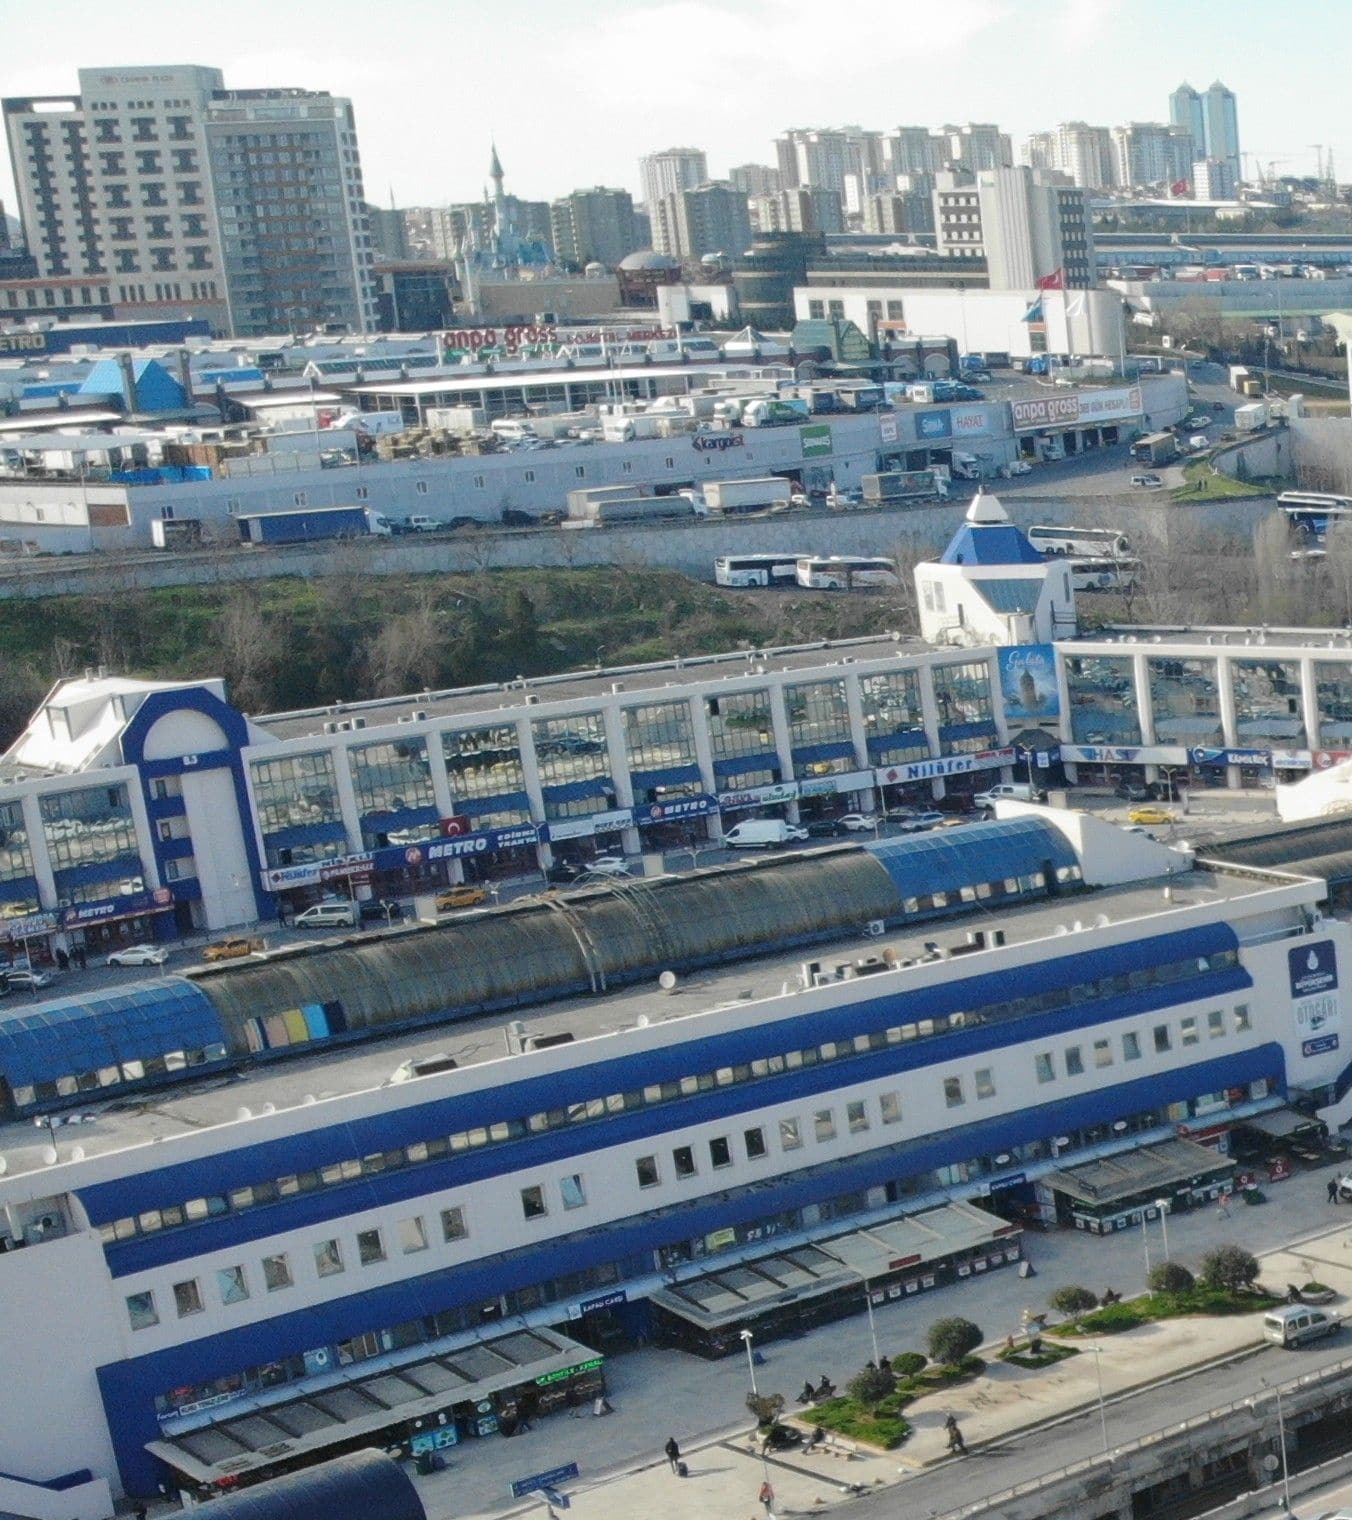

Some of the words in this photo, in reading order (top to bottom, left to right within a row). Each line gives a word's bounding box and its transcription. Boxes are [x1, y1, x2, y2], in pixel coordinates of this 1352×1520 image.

[442, 329, 498, 349] anpa
[504, 325, 559, 353] gross
[1014, 400, 1046, 425] anpa
[1047, 396, 1079, 423] gross
[906, 759, 973, 779] Nilüfer
[664, 800, 707, 814] METRO
[428, 838, 487, 860] METRO
[78, 904, 115, 919] METRO
